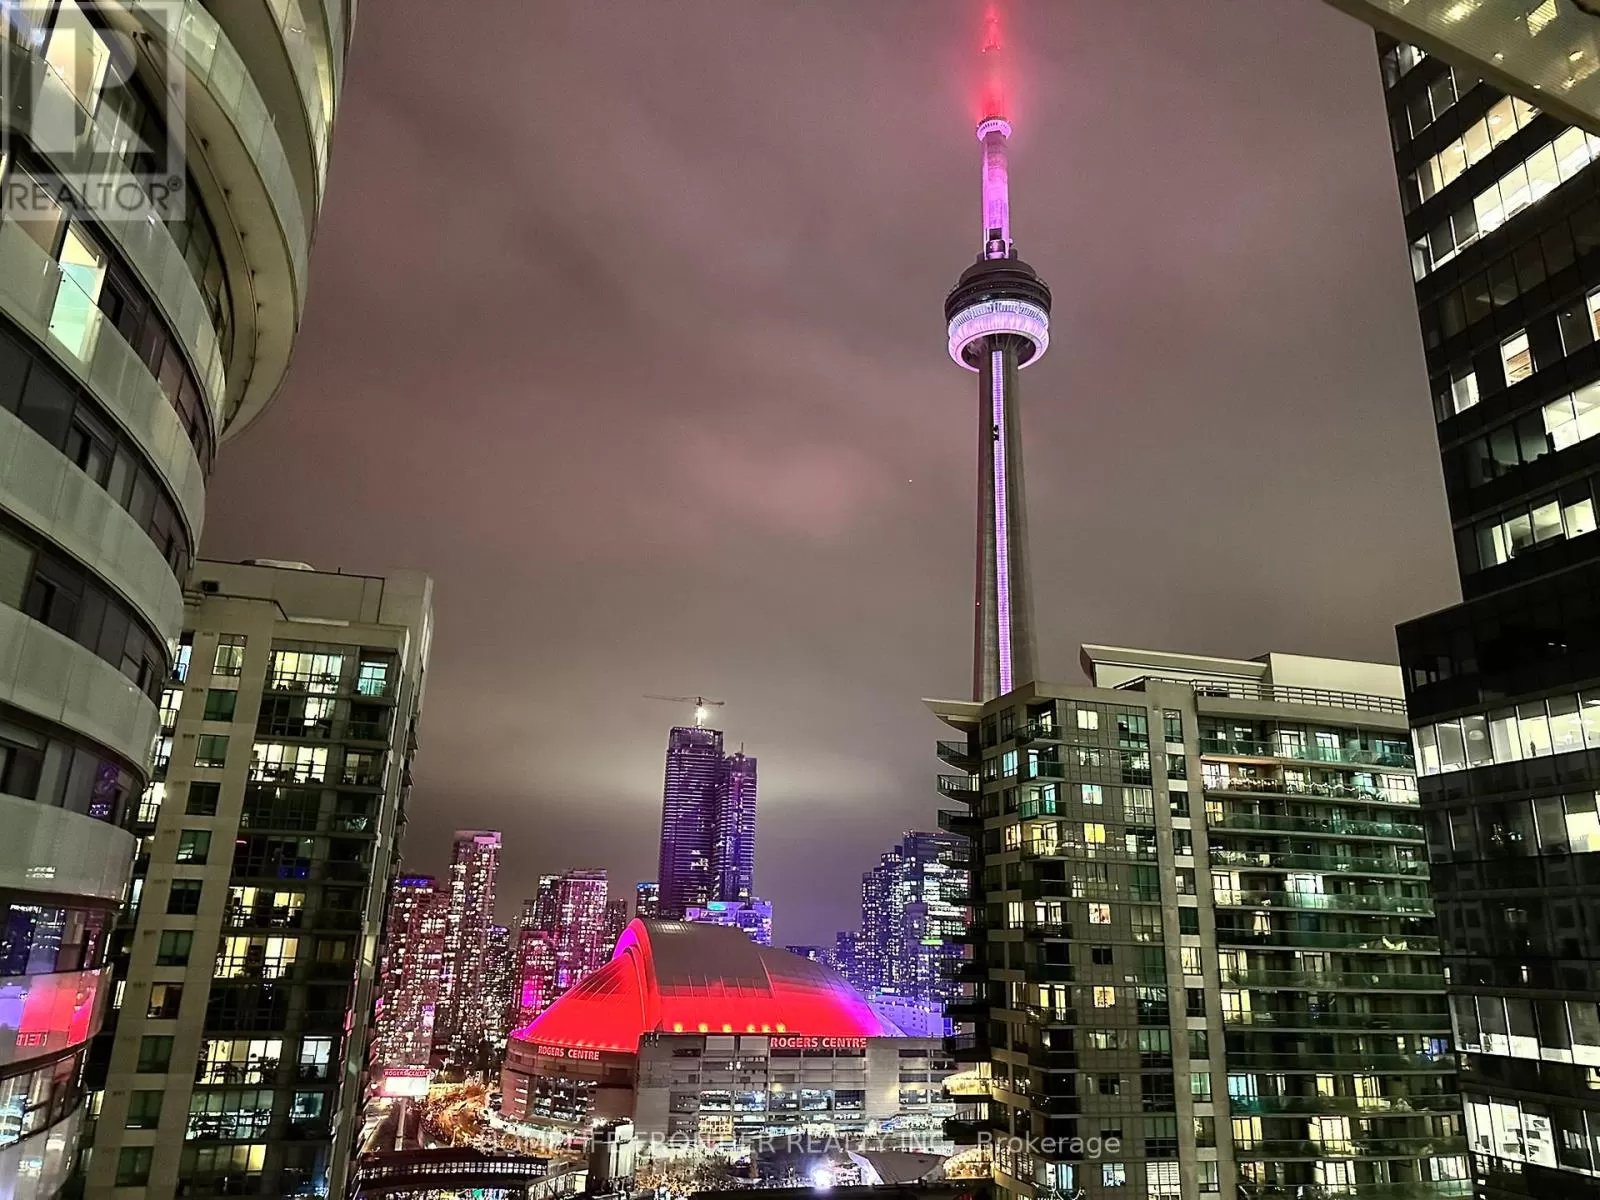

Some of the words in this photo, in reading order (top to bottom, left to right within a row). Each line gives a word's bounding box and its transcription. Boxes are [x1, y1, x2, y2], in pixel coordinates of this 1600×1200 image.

[770, 1037, 818, 1048] ROGERS
[821, 1037, 867, 1048] CENTRE
[538, 1045, 565, 1057] ROGERS
[567, 1048, 600, 1061] CENTRE
